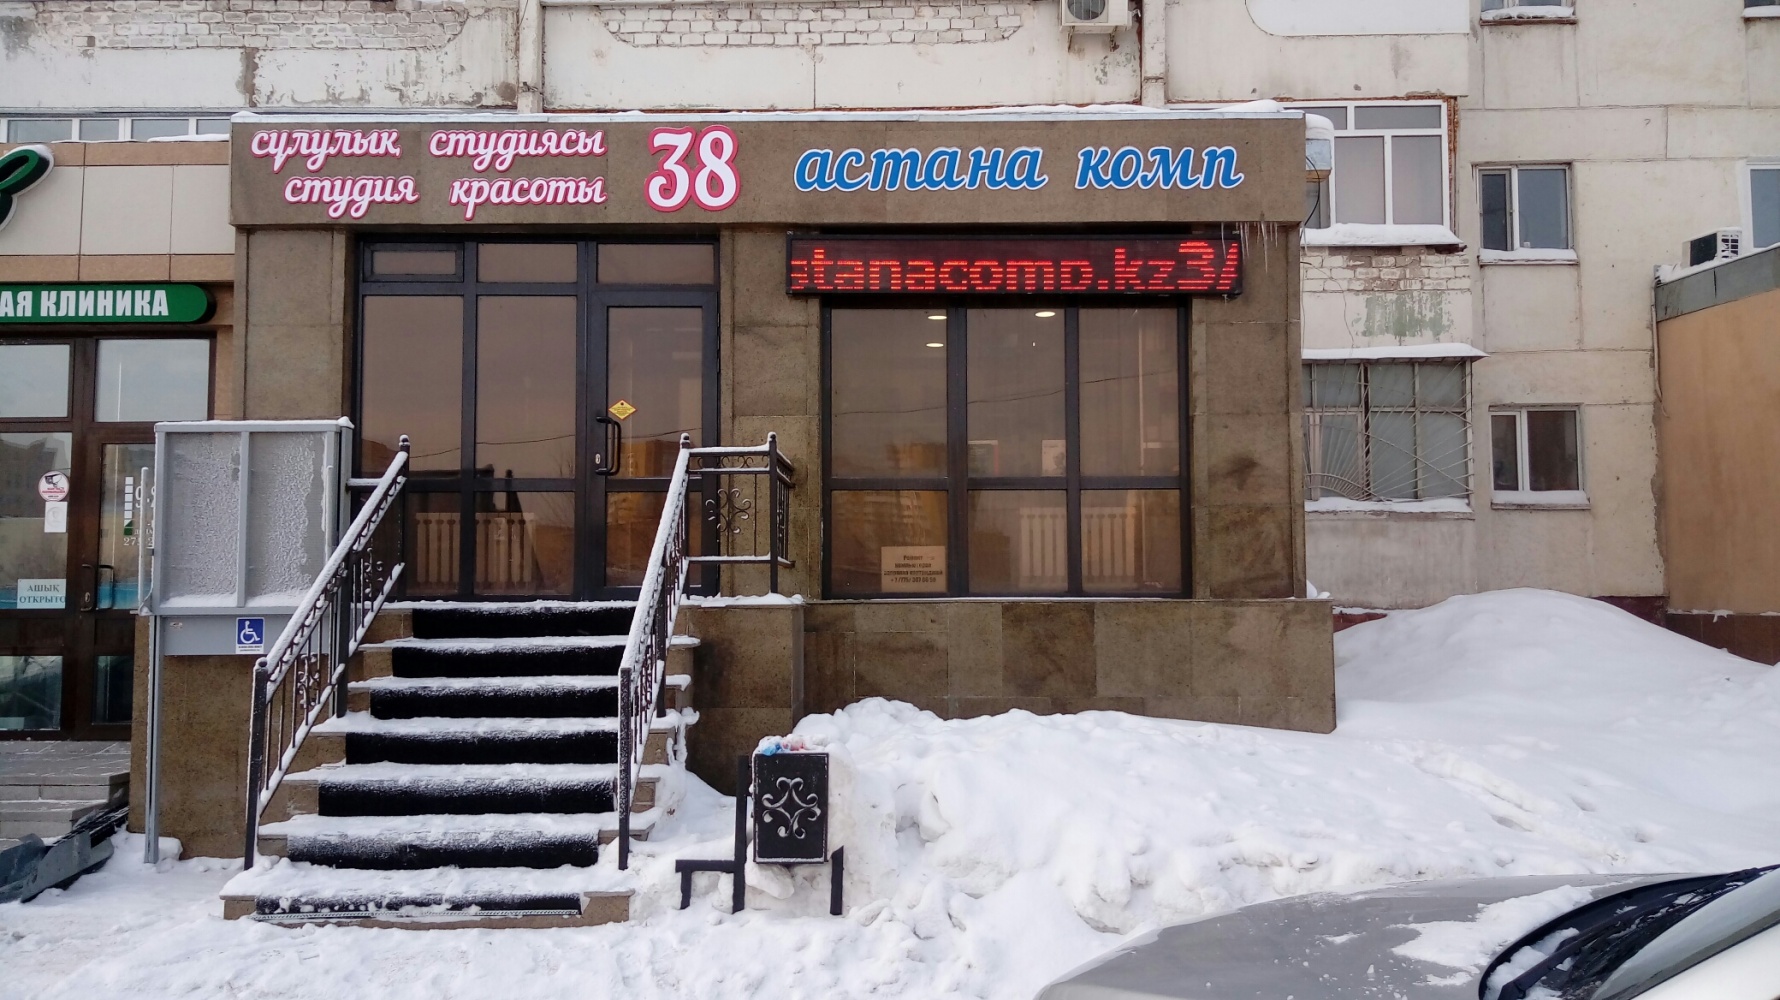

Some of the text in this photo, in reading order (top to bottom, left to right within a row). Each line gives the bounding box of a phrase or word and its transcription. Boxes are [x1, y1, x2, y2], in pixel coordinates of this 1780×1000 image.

[429, 129, 607, 172] студиясы
[645, 124, 741, 212] 38
[794, 146, 1244, 191] астана комп
[284, 176, 607, 220] студия красоты
[40, 290, 169, 316] КЛИНИКА
